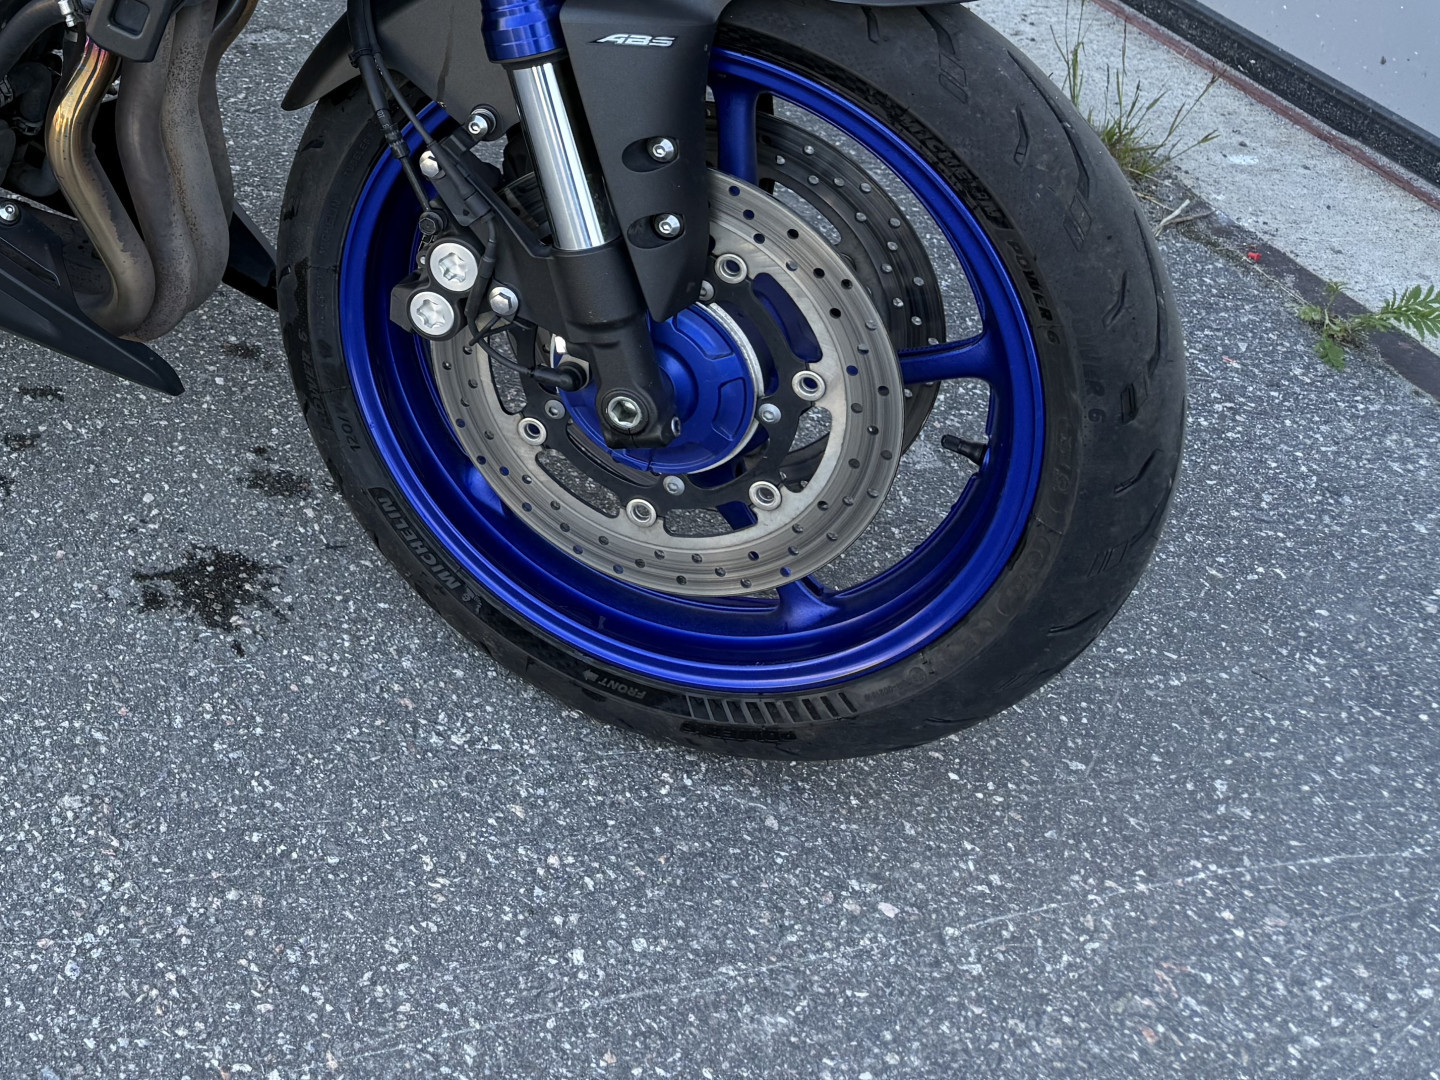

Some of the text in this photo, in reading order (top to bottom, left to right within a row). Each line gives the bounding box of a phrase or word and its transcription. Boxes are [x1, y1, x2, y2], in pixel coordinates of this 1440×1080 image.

[596, 33, 676, 47] ABS
[1007, 239, 1054, 320] POWER
[378, 496, 460, 590] MICHELIN
[598, 678, 647, 700] FRONT
